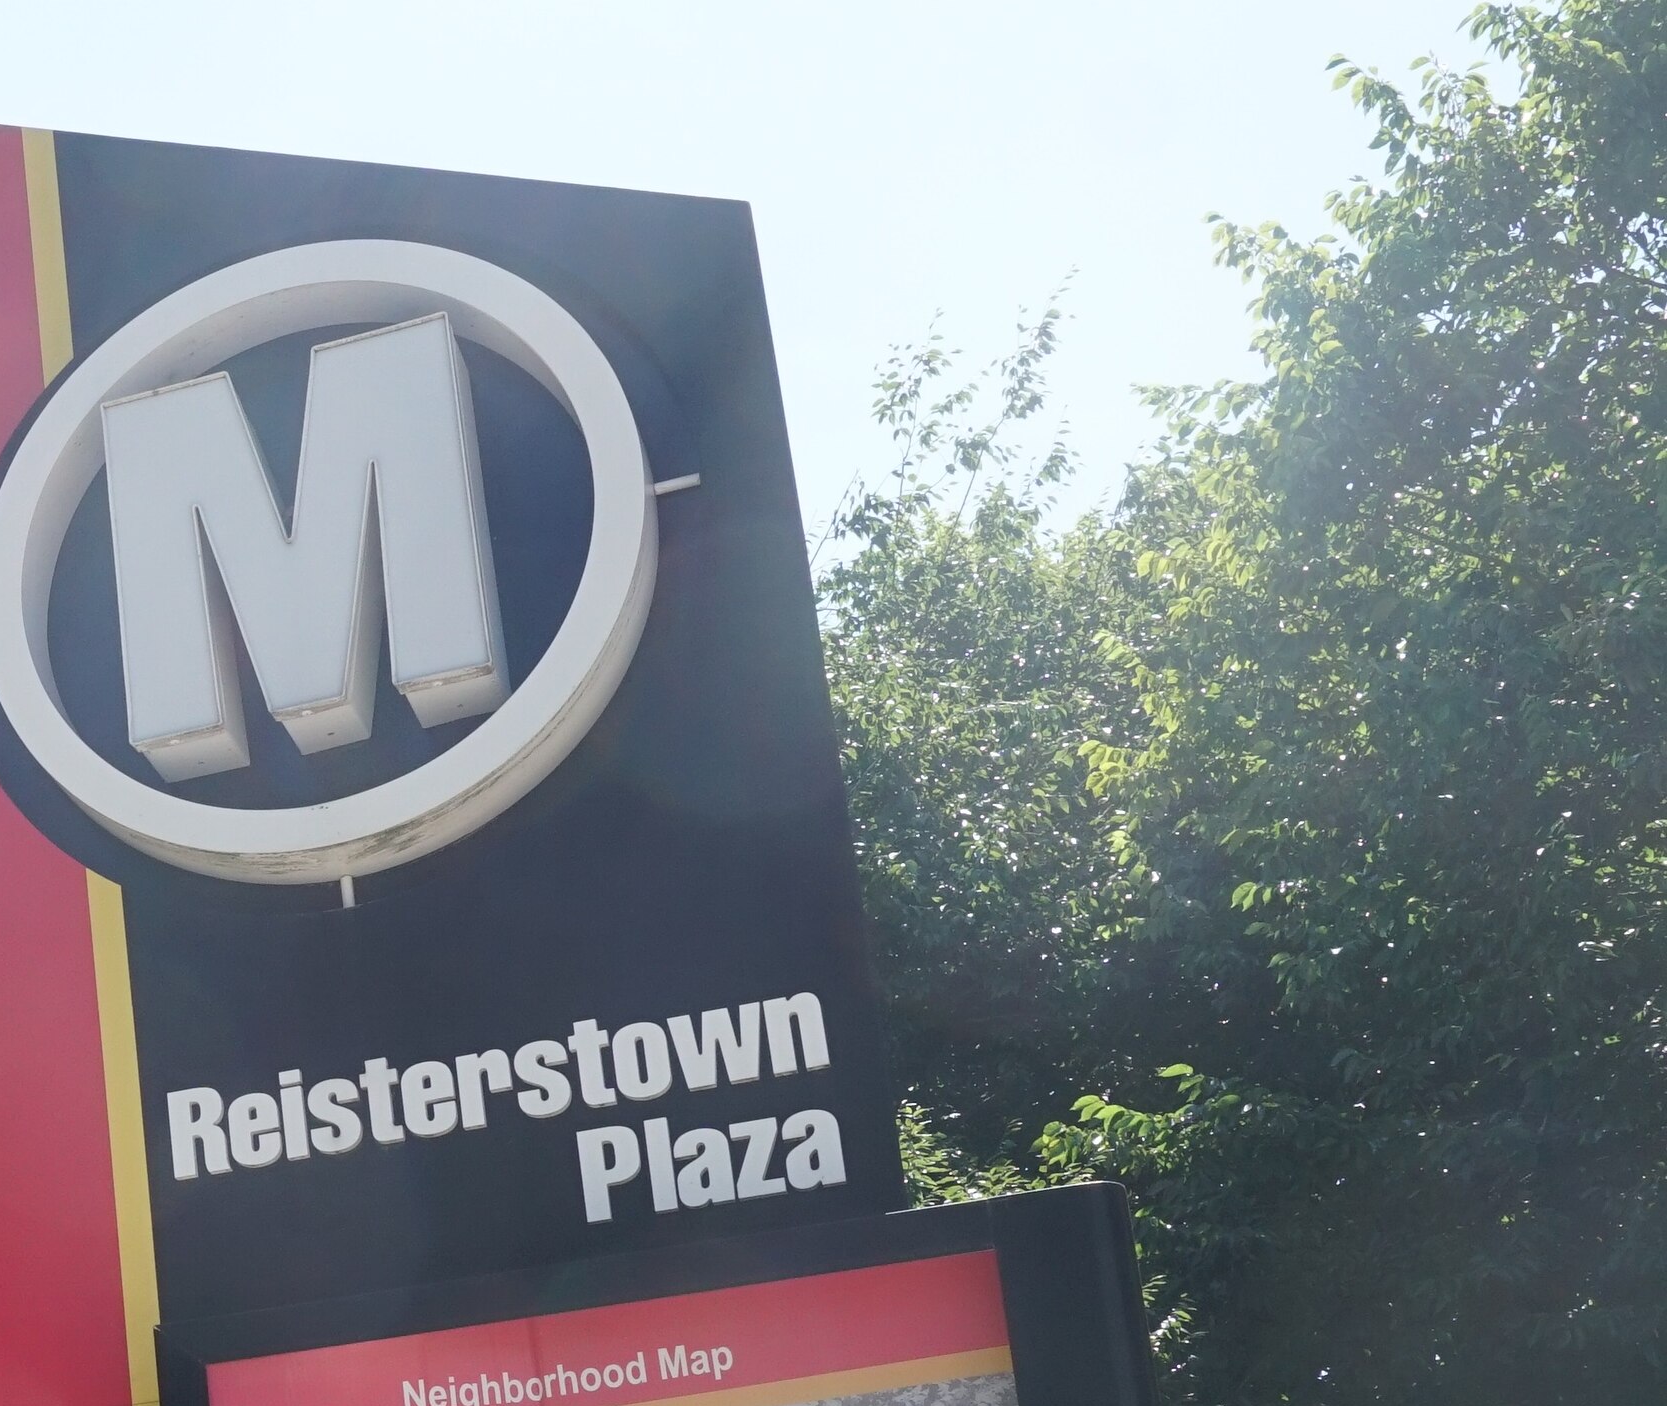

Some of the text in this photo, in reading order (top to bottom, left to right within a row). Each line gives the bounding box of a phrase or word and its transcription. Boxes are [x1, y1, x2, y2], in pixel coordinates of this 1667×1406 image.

[101, 312, 512, 784] M
[166, 989, 830, 1181] Reisterstown
[576, 1109, 847, 1224] Plaza
[657, 1345, 734, 1379] Map
